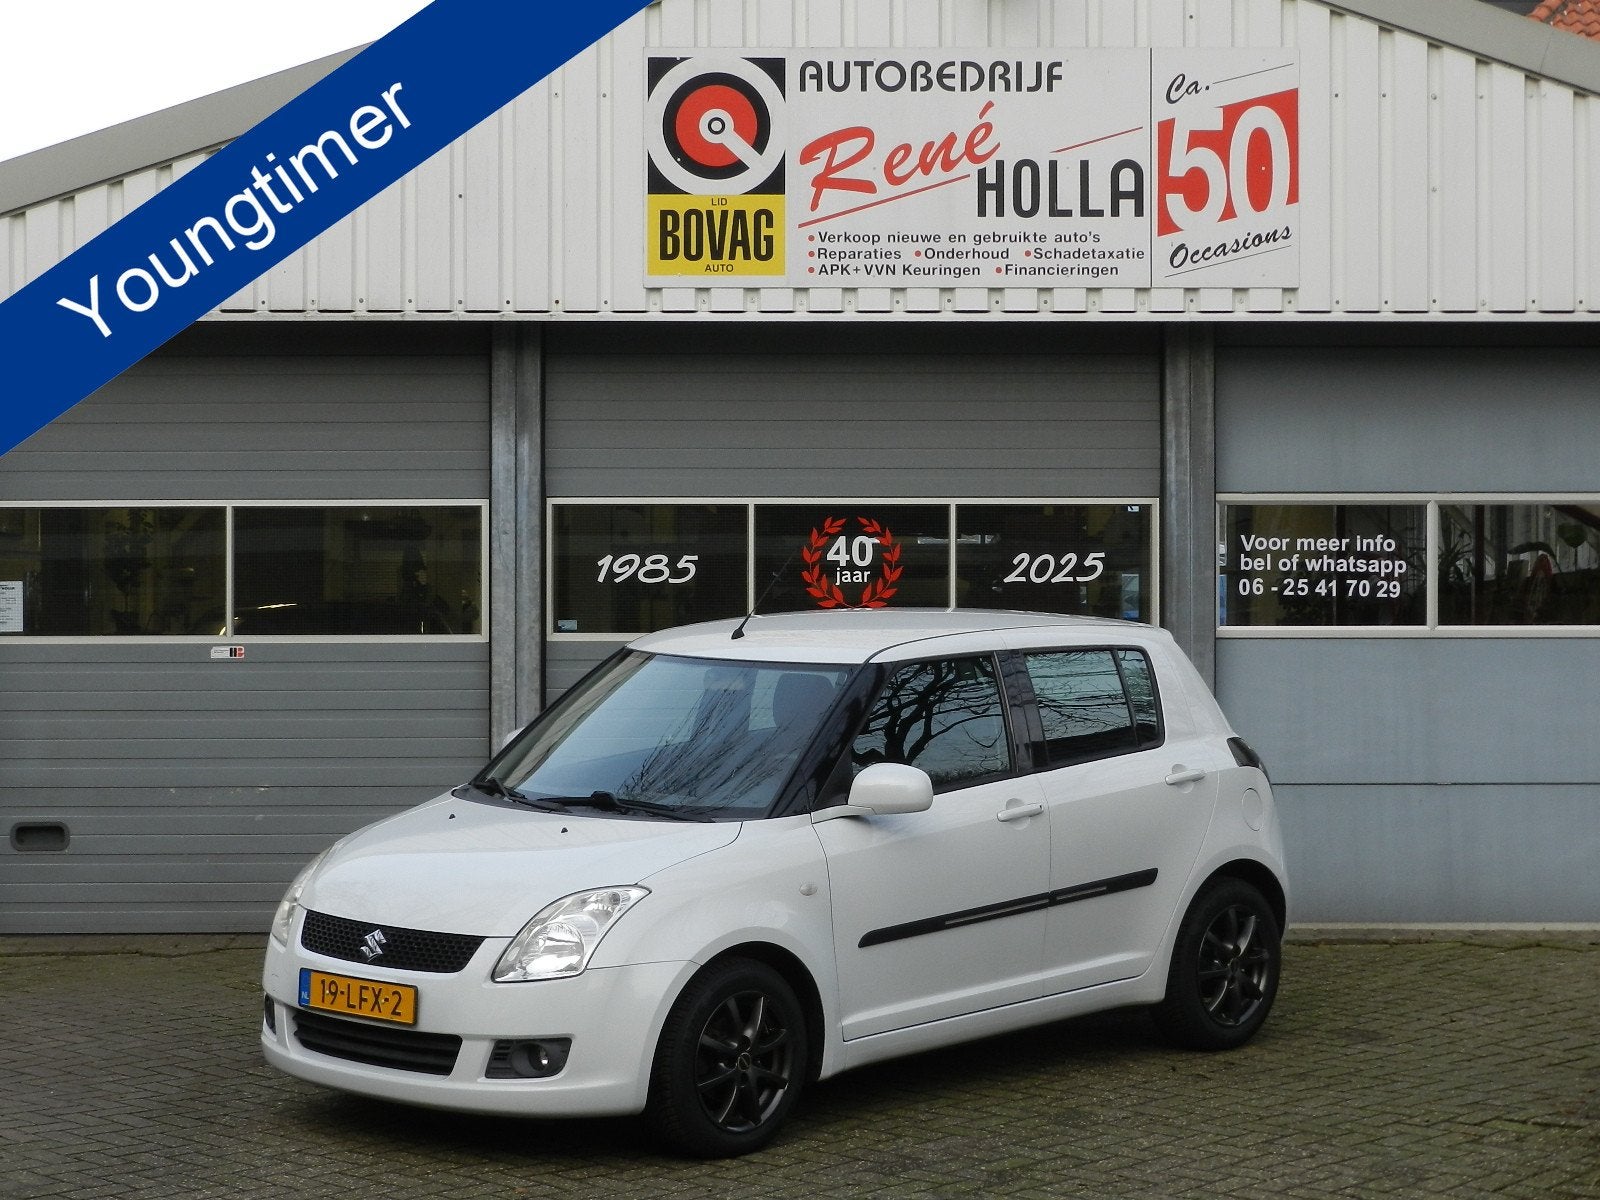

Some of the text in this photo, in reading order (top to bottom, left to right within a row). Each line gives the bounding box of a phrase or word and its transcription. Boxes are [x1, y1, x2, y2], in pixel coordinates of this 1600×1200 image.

[800, 61, 1062, 92] AUTOBEDRIJF
[1166, 73, 1209, 104] Ca.
[799, 100, 1144, 217] René HOLLA
[1165, 106, 1290, 232] 50
[711, 198, 727, 207] LID
[660, 209, 773, 261] BOVAG
[818, 232, 1100, 245] Verkoop nieuwe en gebruikte auto's
[818, 248, 901, 262] Reparaties
[925, 248, 1008, 259] Onderhoud
[1034, 248, 1144, 259] Schadetaxatie
[1169, 226, 1292, 268] Occasions
[704, 263, 734, 273] AUTO
[903, 264, 980, 278] Keuringen
[1006, 264, 1118, 278] Financieringen
[826, 535, 874, 567] 40
[1241, 535, 1290, 551] Voor
[1297, 538, 1350, 551] meer
[597, 554, 698, 583] 1985
[836, 567, 870, 585] jaar
[1004, 552, 1105, 583] 2025
[1241, 554, 1406, 577] bel of whatsapp
[1239, 578, 1263, 595] 06
[1283, 579, 1308, 595] 25
[1315, 579, 1336, 596] 41
[1347, 580, 1370, 596] 70
[1377, 581, 1400, 598] 29
[320, 979, 402, 1016] 19-LFX-2
